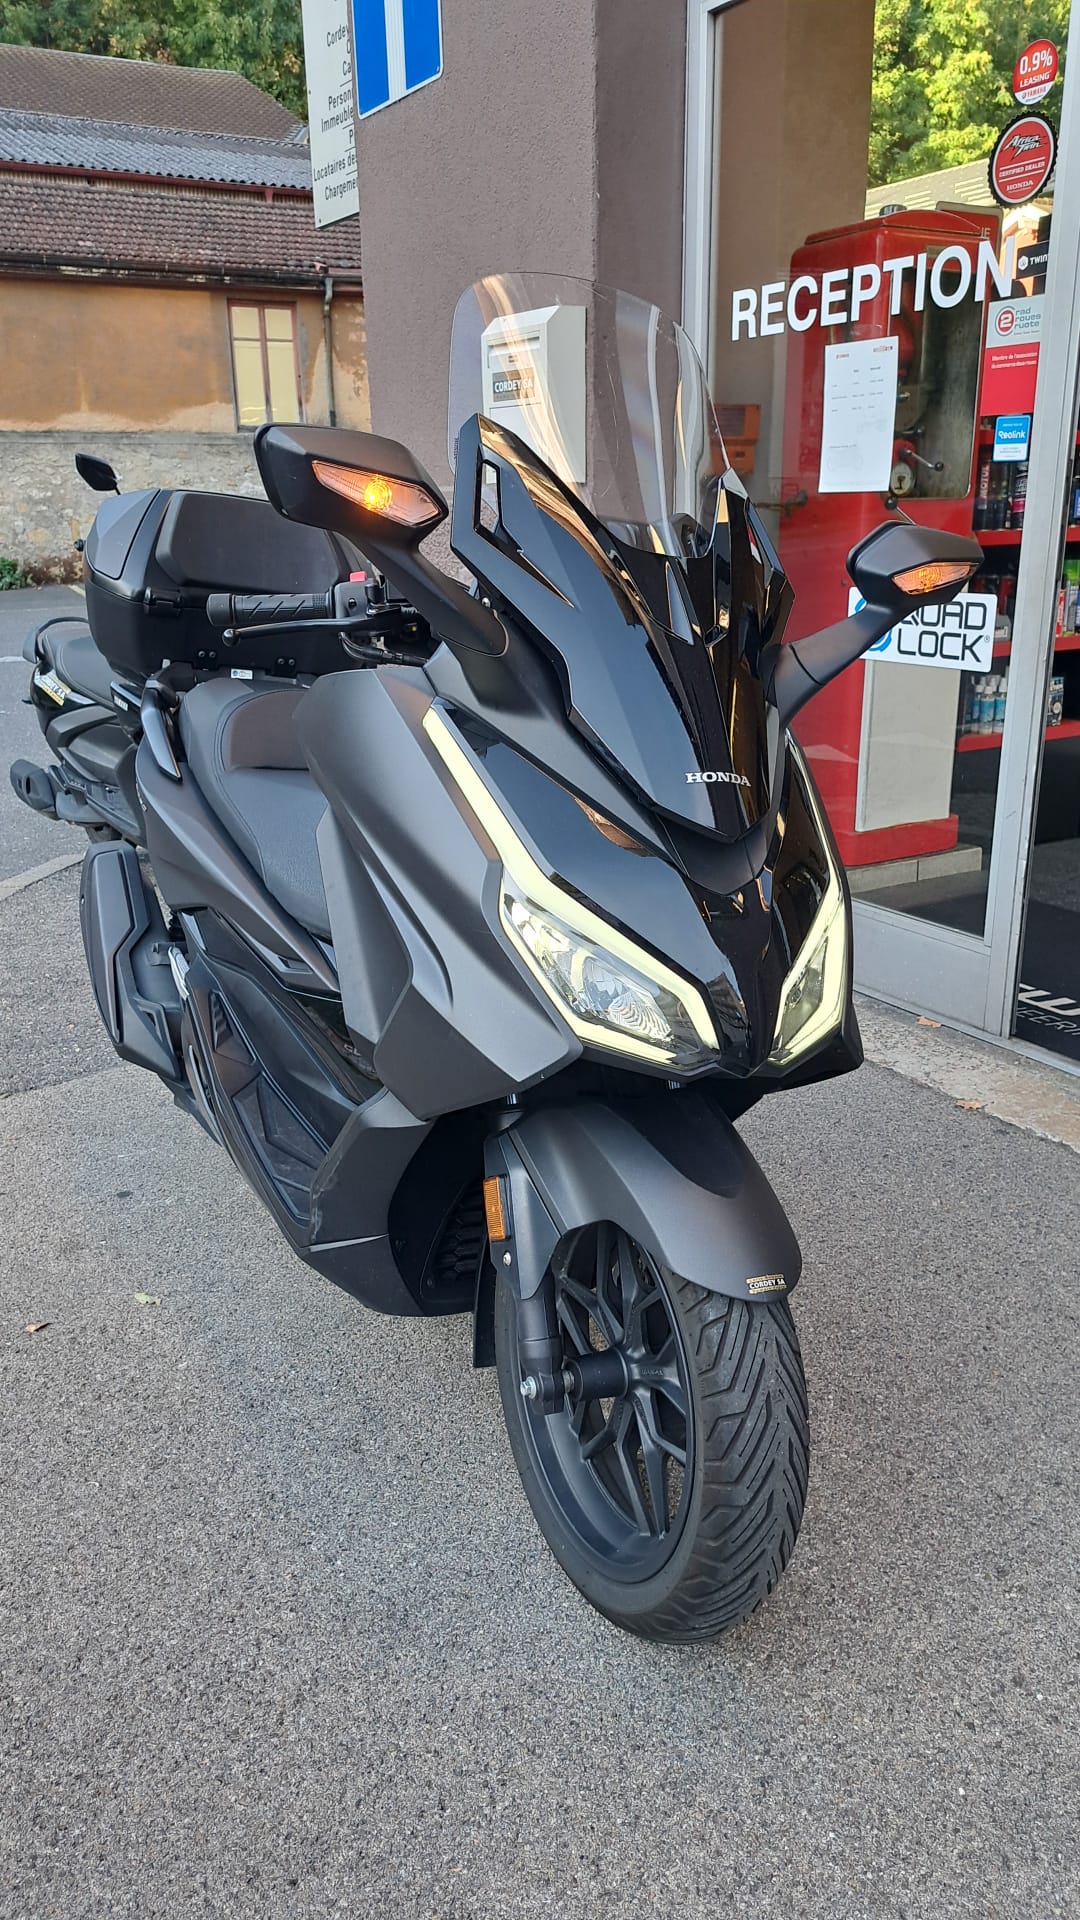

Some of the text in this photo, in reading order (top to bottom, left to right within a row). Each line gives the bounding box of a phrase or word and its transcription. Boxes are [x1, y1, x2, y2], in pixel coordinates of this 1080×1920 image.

[1019, 48, 1053, 75] 0.9%
[1020, 71, 1051, 88] LEASING
[314, 158, 346, 181] Locataires
[731, 236, 1016, 341] RECEPTION
[1015, 307, 1031, 316] rad
[1015, 313, 1041, 323] roues
[1014, 321, 1040, 330] ruote
[494, 380, 521, 393] CORDEY
[685, 771, 752, 787] HONDA
[749, 1279, 776, 1289] CORDEY
